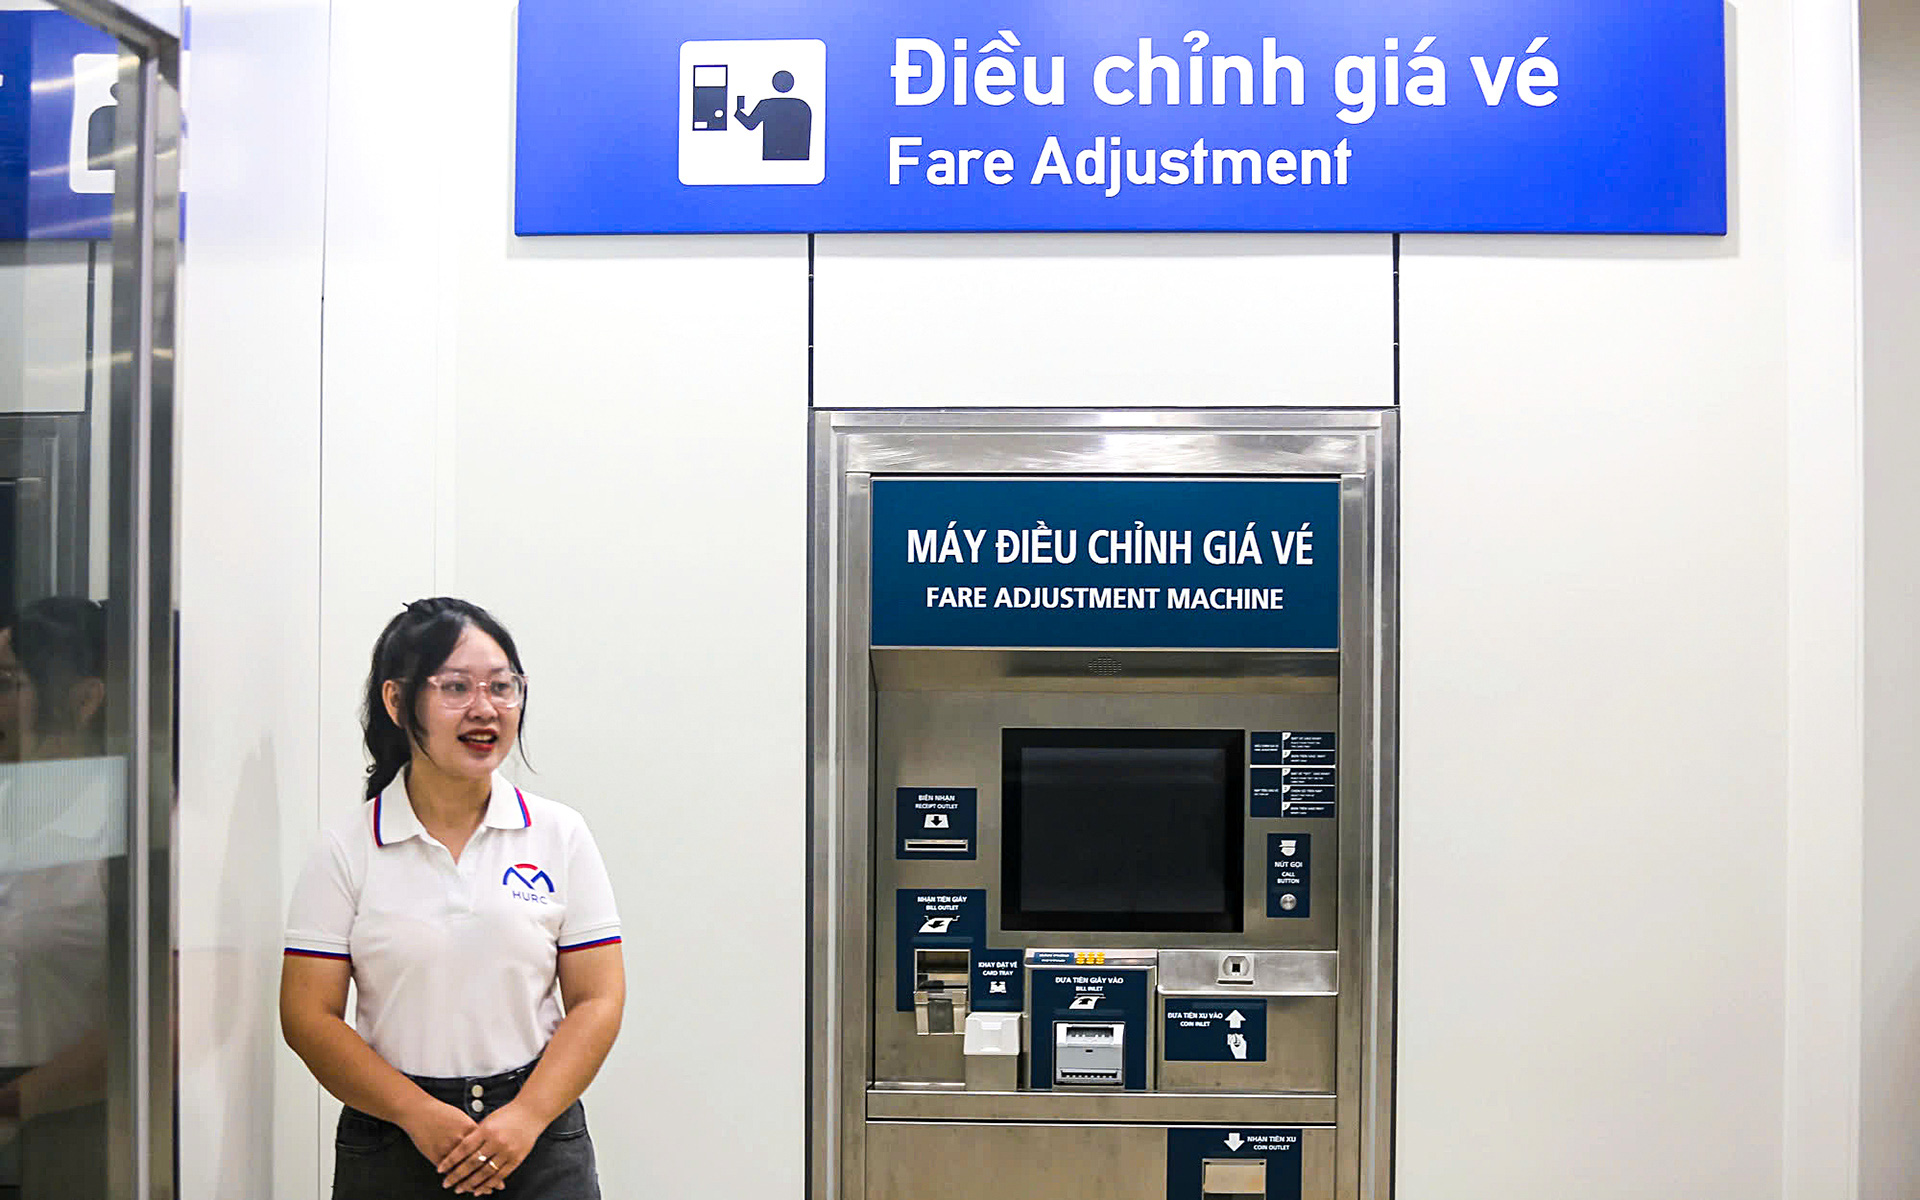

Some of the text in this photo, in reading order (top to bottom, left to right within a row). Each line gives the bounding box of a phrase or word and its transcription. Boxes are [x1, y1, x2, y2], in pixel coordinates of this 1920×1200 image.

[890, 30, 1559, 125] Điều chỉnh giá vé
[889, 136, 1352, 198] Fare Adjustment
[907, 520, 1314, 565] MÁY ĐIỀU CHỈNH GIÁ VÉ
[926, 586, 1284, 610] FARE ADJUSTMENT MACHINE
[512, 890, 548, 905] HURC
